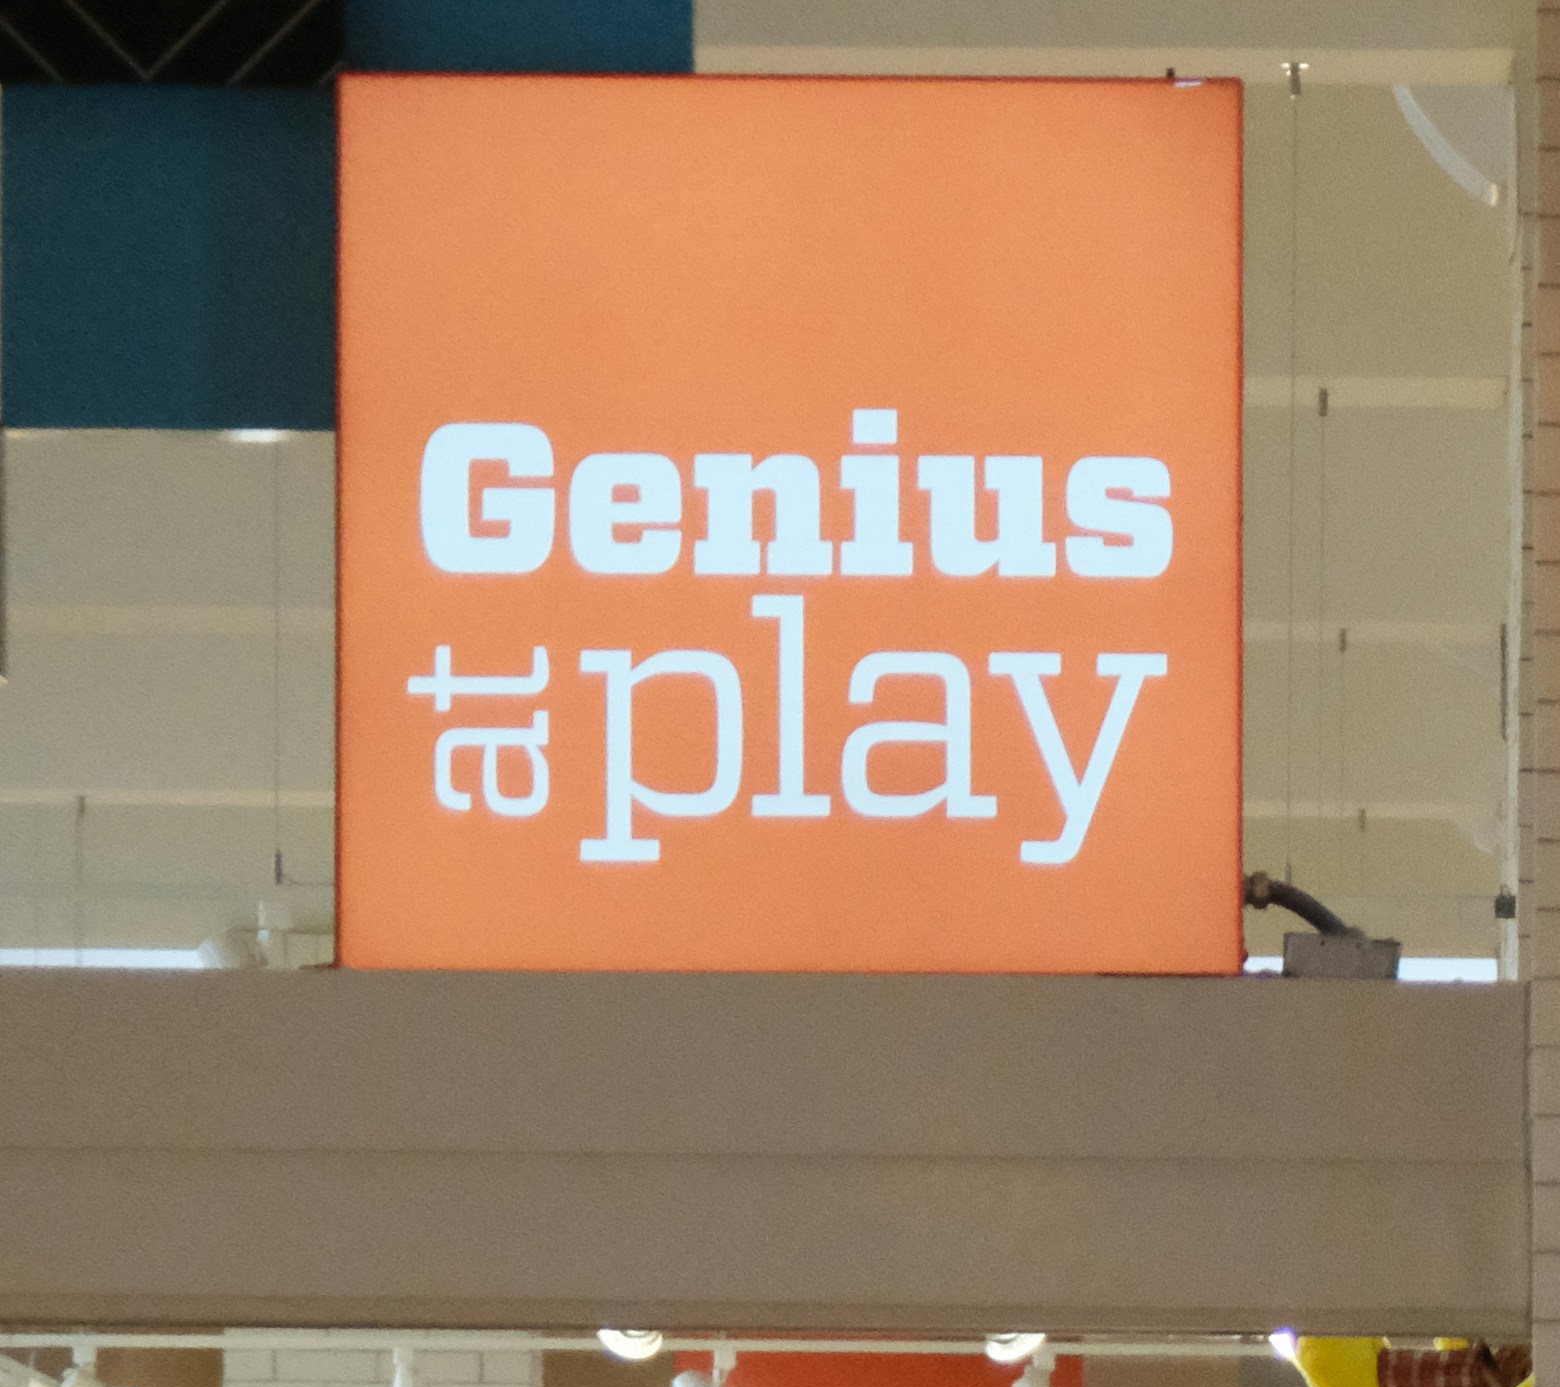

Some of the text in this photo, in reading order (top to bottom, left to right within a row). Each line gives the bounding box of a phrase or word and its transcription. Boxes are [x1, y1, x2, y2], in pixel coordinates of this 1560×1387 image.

[420, 409, 1173, 577] Genius
[407, 643, 550, 816] at
[579, 595, 1168, 864] play
